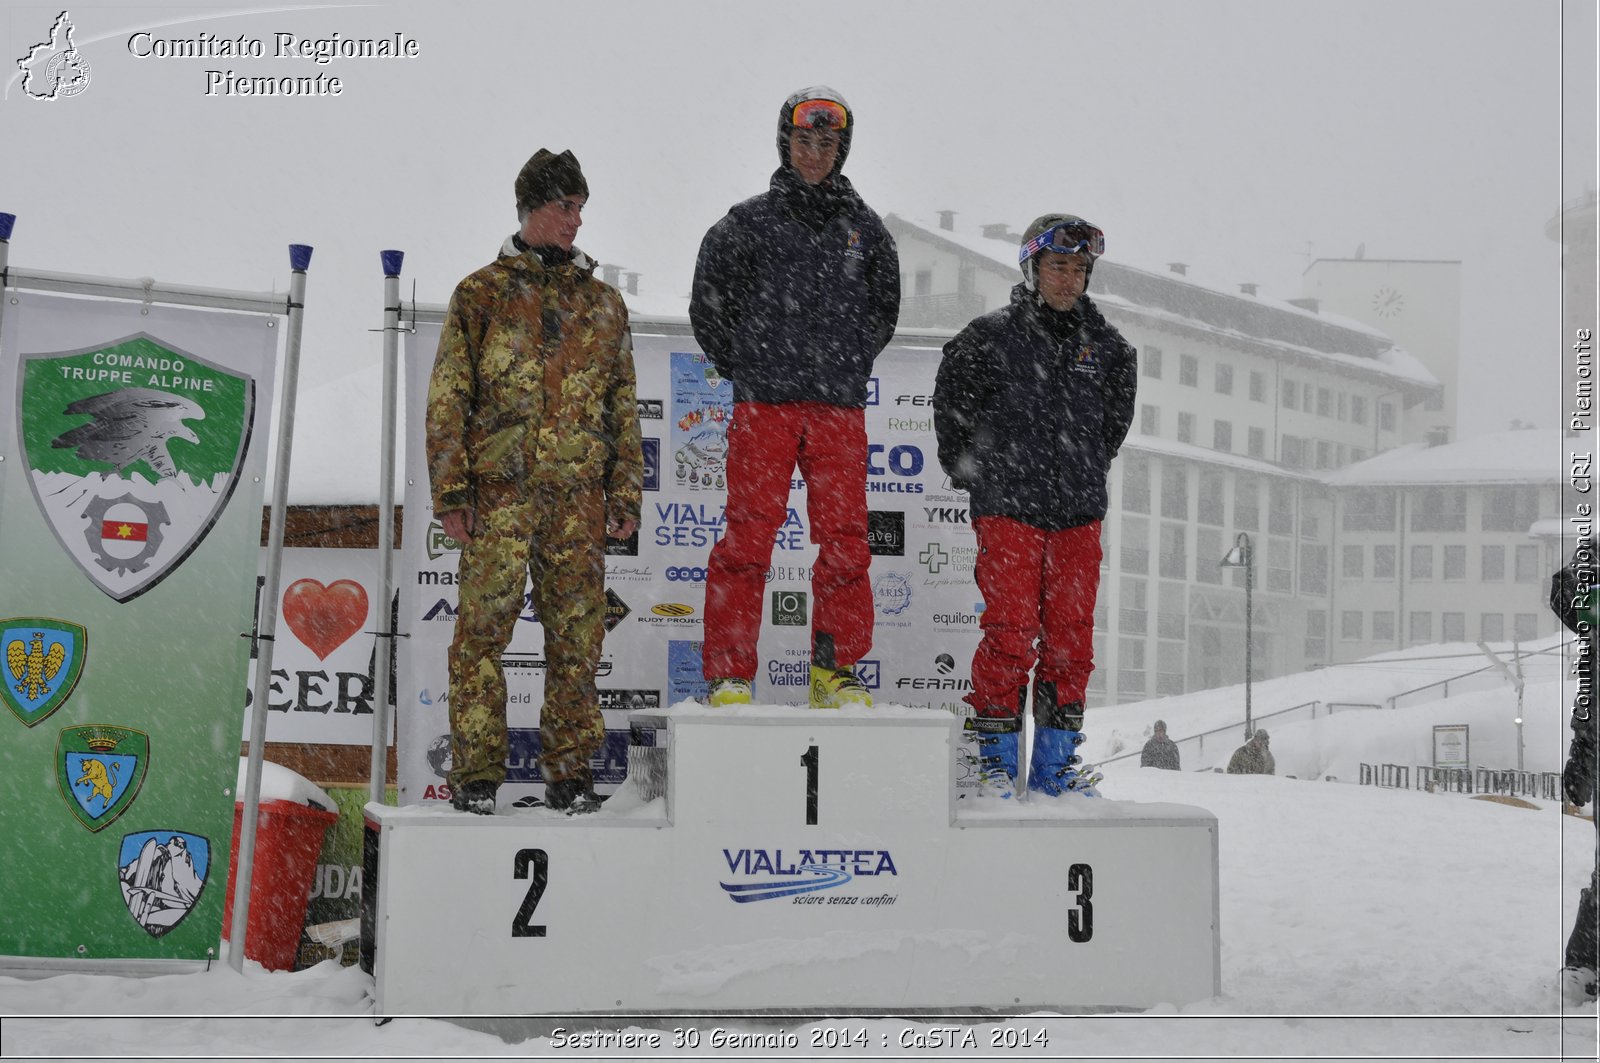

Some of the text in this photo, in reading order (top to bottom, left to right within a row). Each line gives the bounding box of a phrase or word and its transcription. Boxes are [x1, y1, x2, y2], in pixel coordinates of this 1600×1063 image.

[93, 353, 185, 372] COMANDO
[61, 366, 213, 391] TRUPPE ALPINE
[888, 418, 932, 431] Rebel
[923, 507, 968, 524] YKK
[952, 547, 978, 555] FARMA
[952, 555, 977, 564] COMU
[952, 563, 975, 572] TORIN
[879, 588, 905, 597] ARIS
[932, 612, 977, 626] equilon
[768, 660, 812, 673] Credit
[768, 673, 810, 685] Valtell
[895, 678, 975, 691] FERRIN
[800, 745, 819, 826] 1
[723, 849, 898, 876] VIALATTEA
[511, 848, 549, 938] 2
[792, 893, 898, 907] sciare senza confini
[1067, 863, 1093, 943] 3
